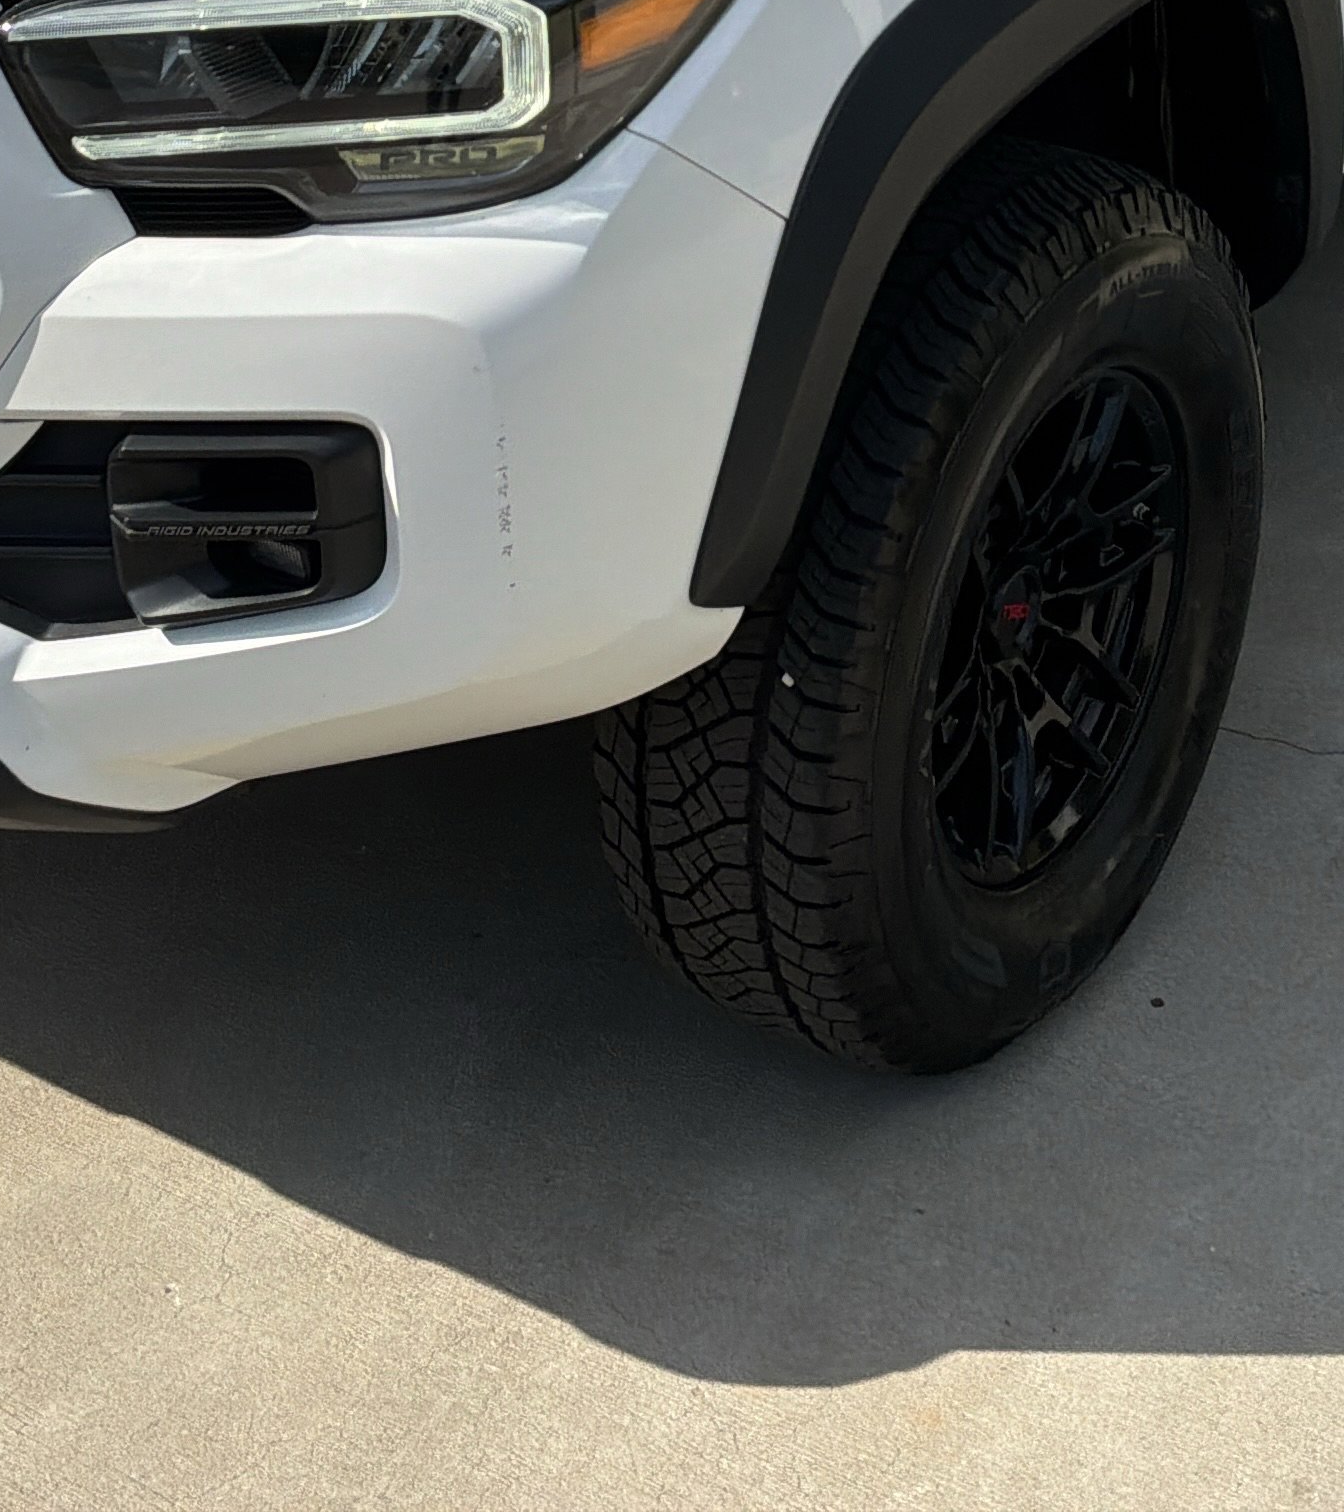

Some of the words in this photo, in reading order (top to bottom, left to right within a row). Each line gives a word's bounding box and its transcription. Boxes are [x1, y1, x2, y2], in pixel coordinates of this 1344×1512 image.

[379, 144, 498, 171] PRO
[146, 525, 192, 537] RIGID
[196, 524, 311, 537] INDUSTRIES
